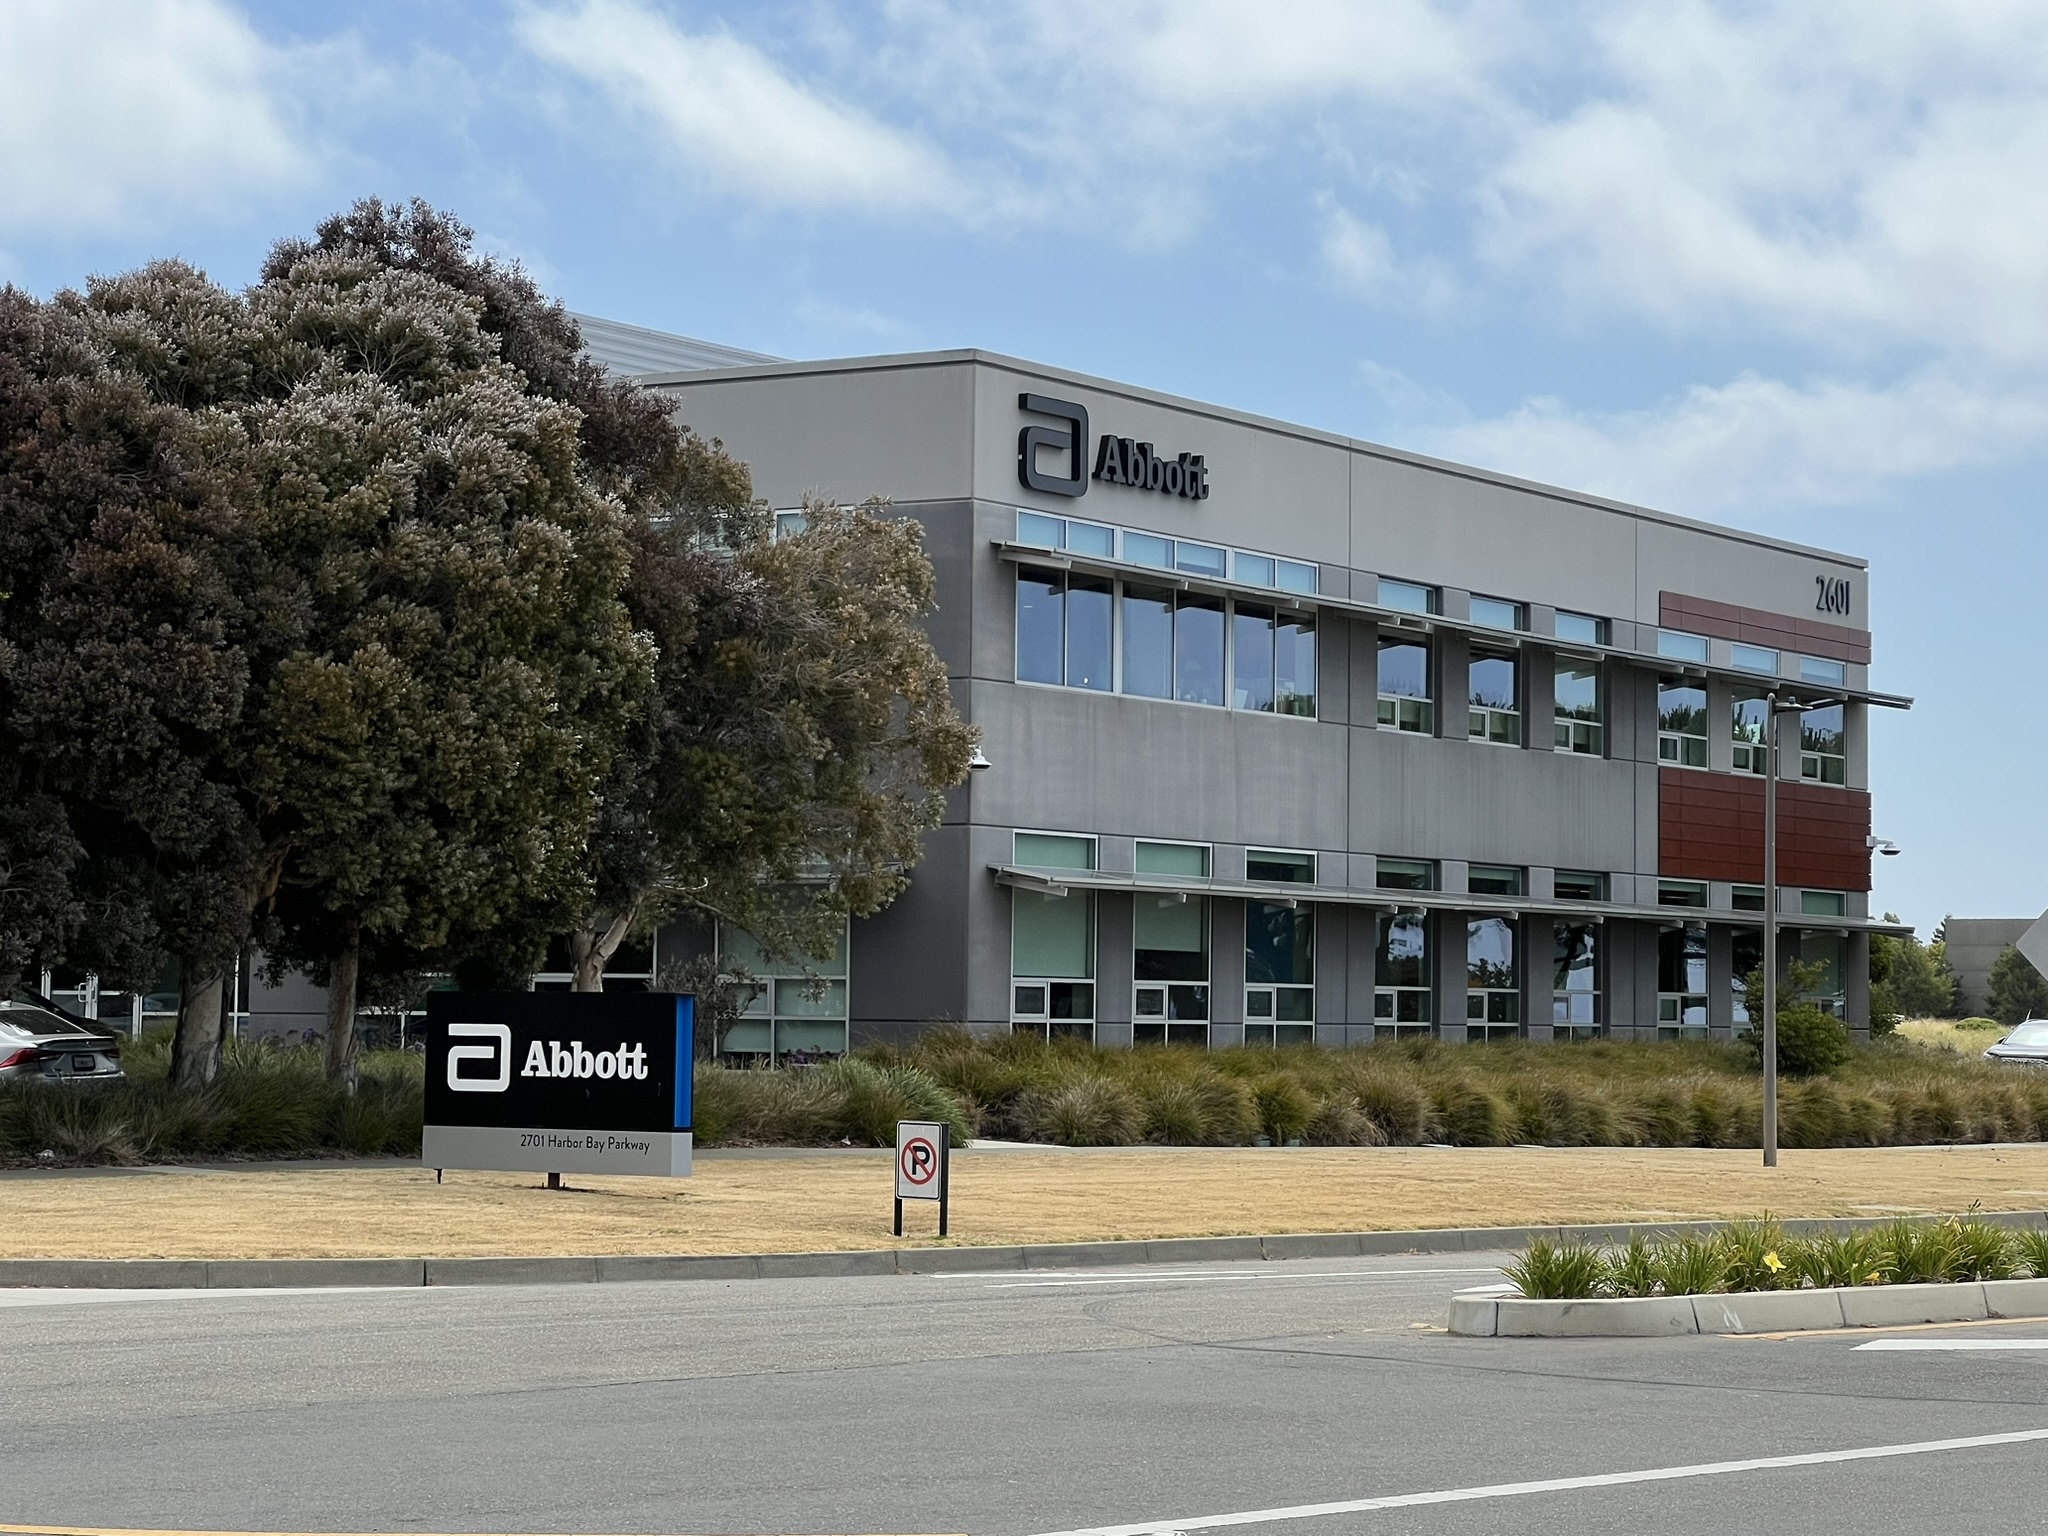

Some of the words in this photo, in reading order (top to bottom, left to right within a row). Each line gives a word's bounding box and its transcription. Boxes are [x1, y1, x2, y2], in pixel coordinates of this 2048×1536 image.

[1092, 435, 1209, 499] Abbott
[1816, 575, 1850, 616] 2601
[521, 1041, 648, 1080] Abbott
[520, 1134, 545, 1148] 2701
[548, 1135, 583, 1149] Harbor
[586, 1136, 605, 1153] Bay
[608, 1137, 650, 1155] Parkway
